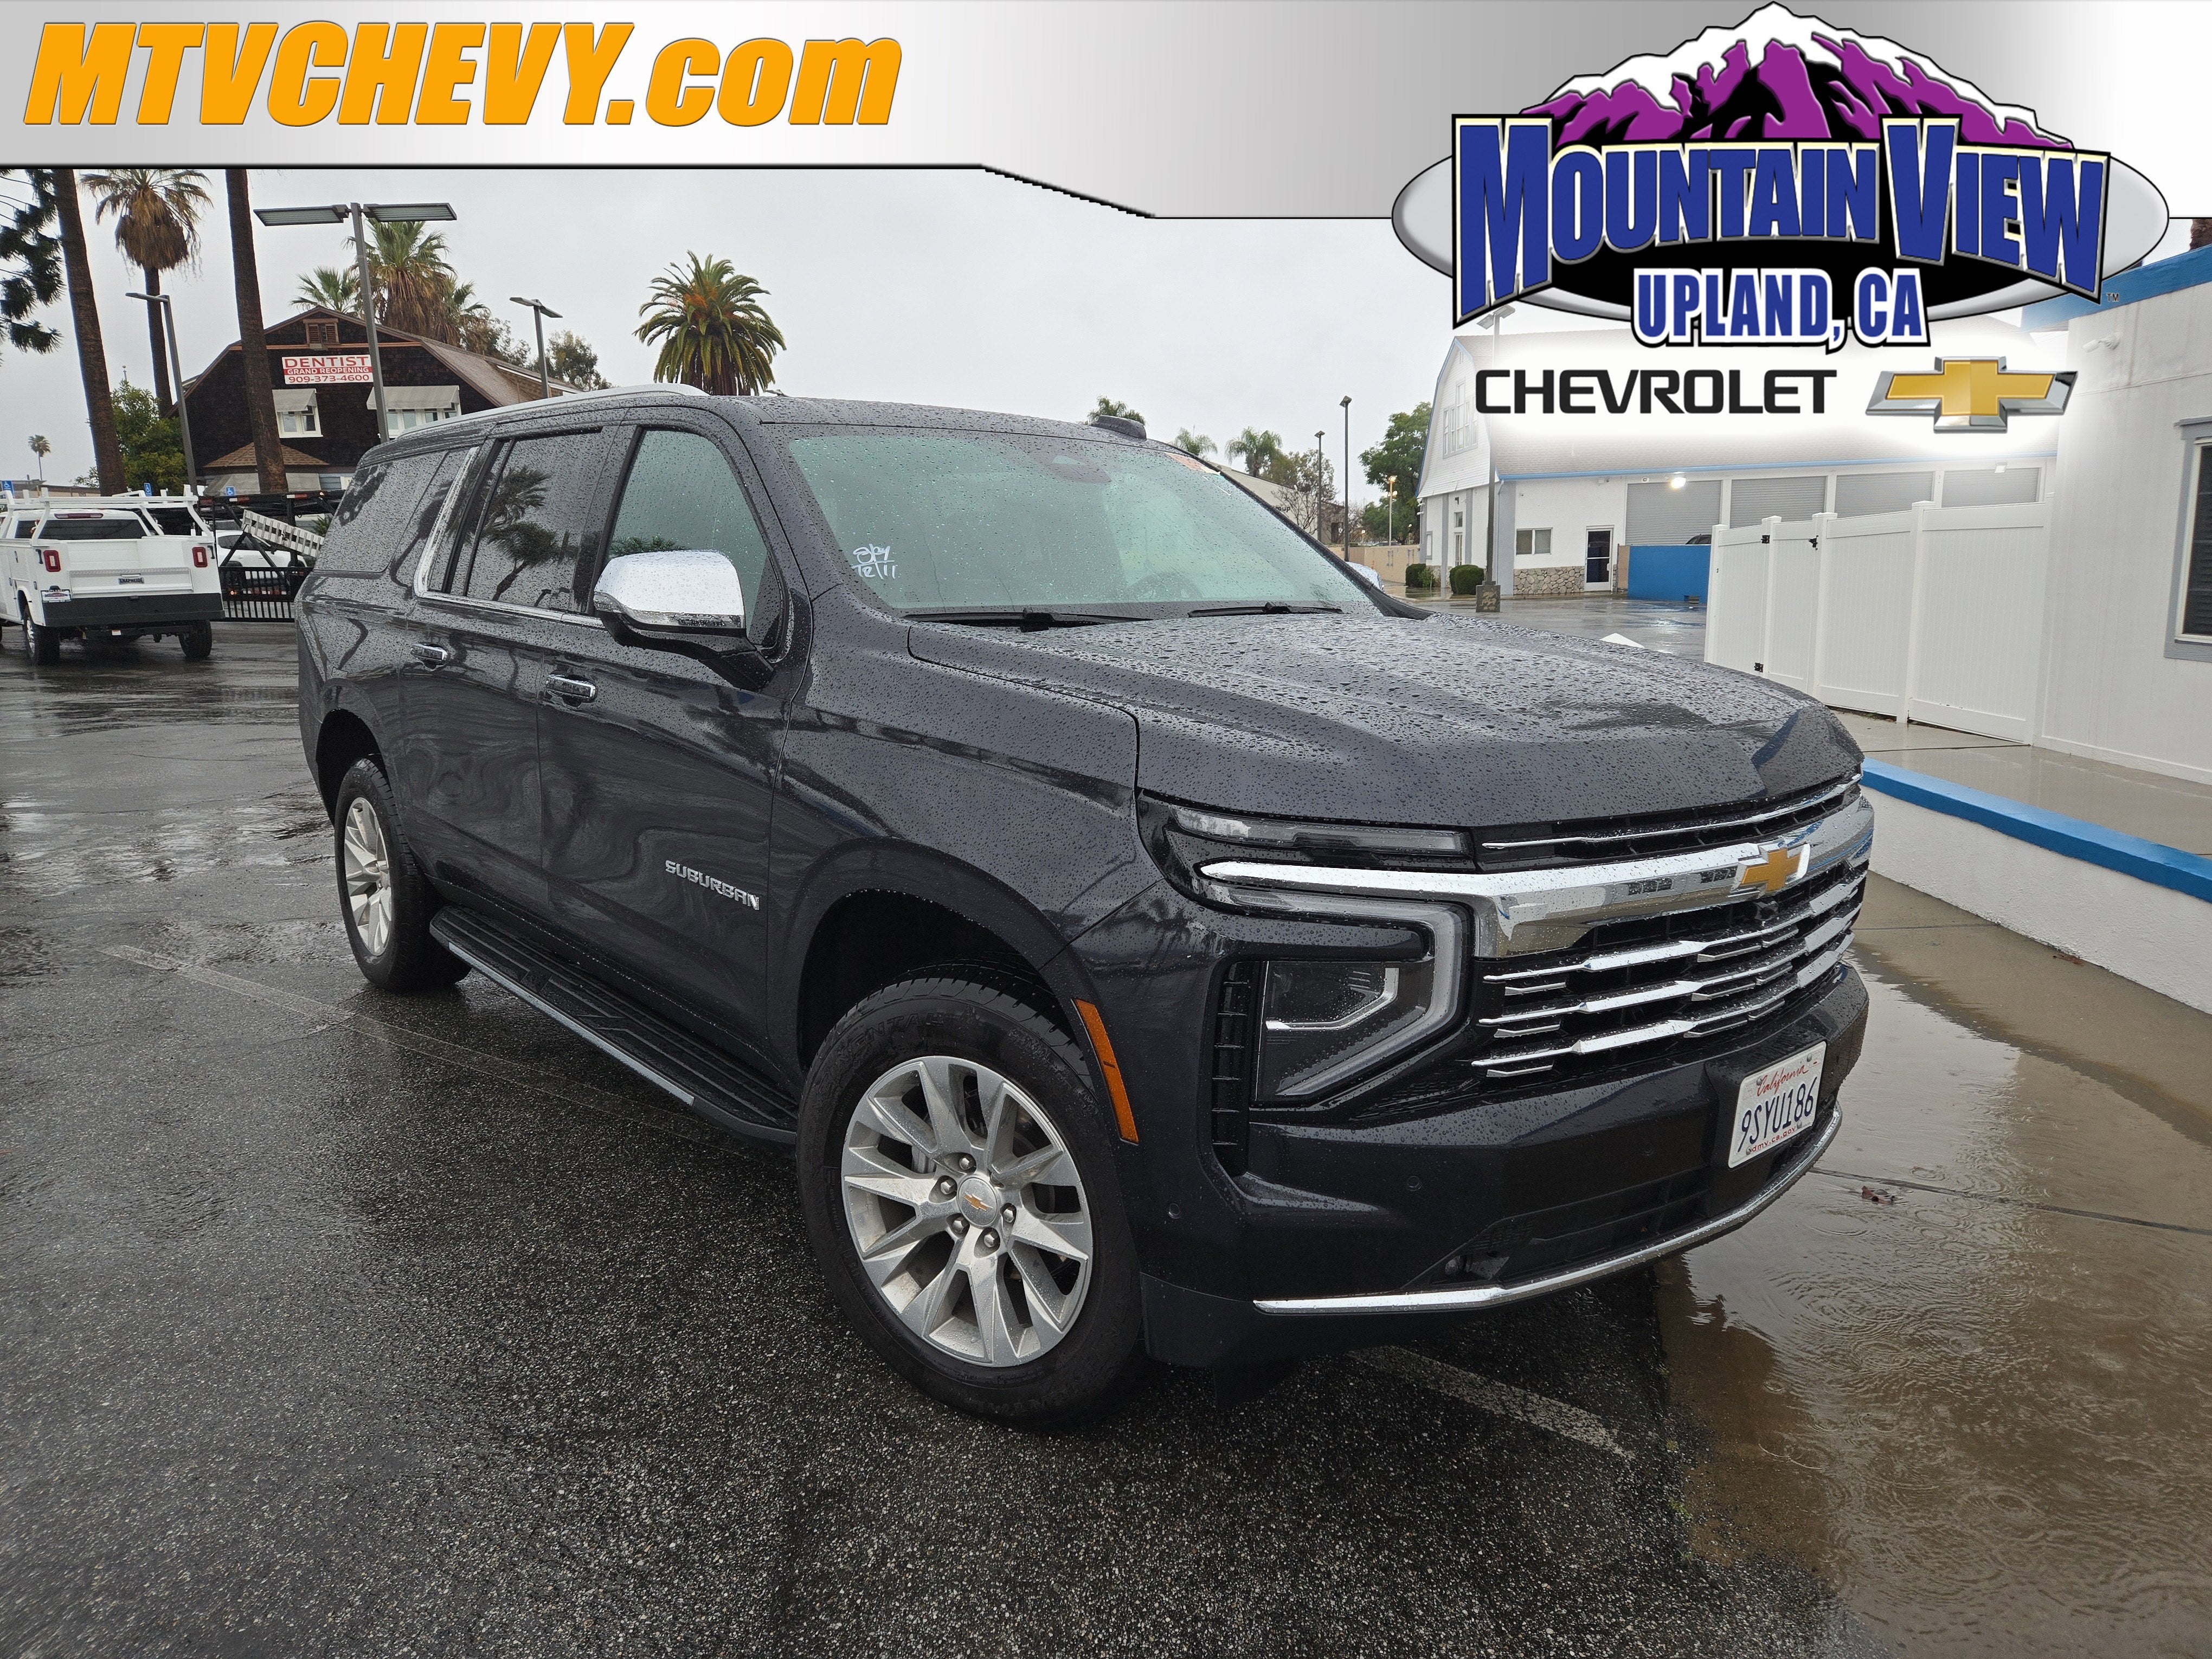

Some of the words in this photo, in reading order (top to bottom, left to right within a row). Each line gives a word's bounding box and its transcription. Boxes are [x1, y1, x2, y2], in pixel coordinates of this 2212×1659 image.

[284, 356, 369, 368] DENTIST
[288, 374, 369, 383] 909-373-4600
[665, 860, 760, 910] SUBURBAN
[1757, 1064, 1809, 1096] California
[1738, 1076, 1818, 1152] 9SYU186
[1752, 1126, 1796, 1152] dmv.ca.gov
